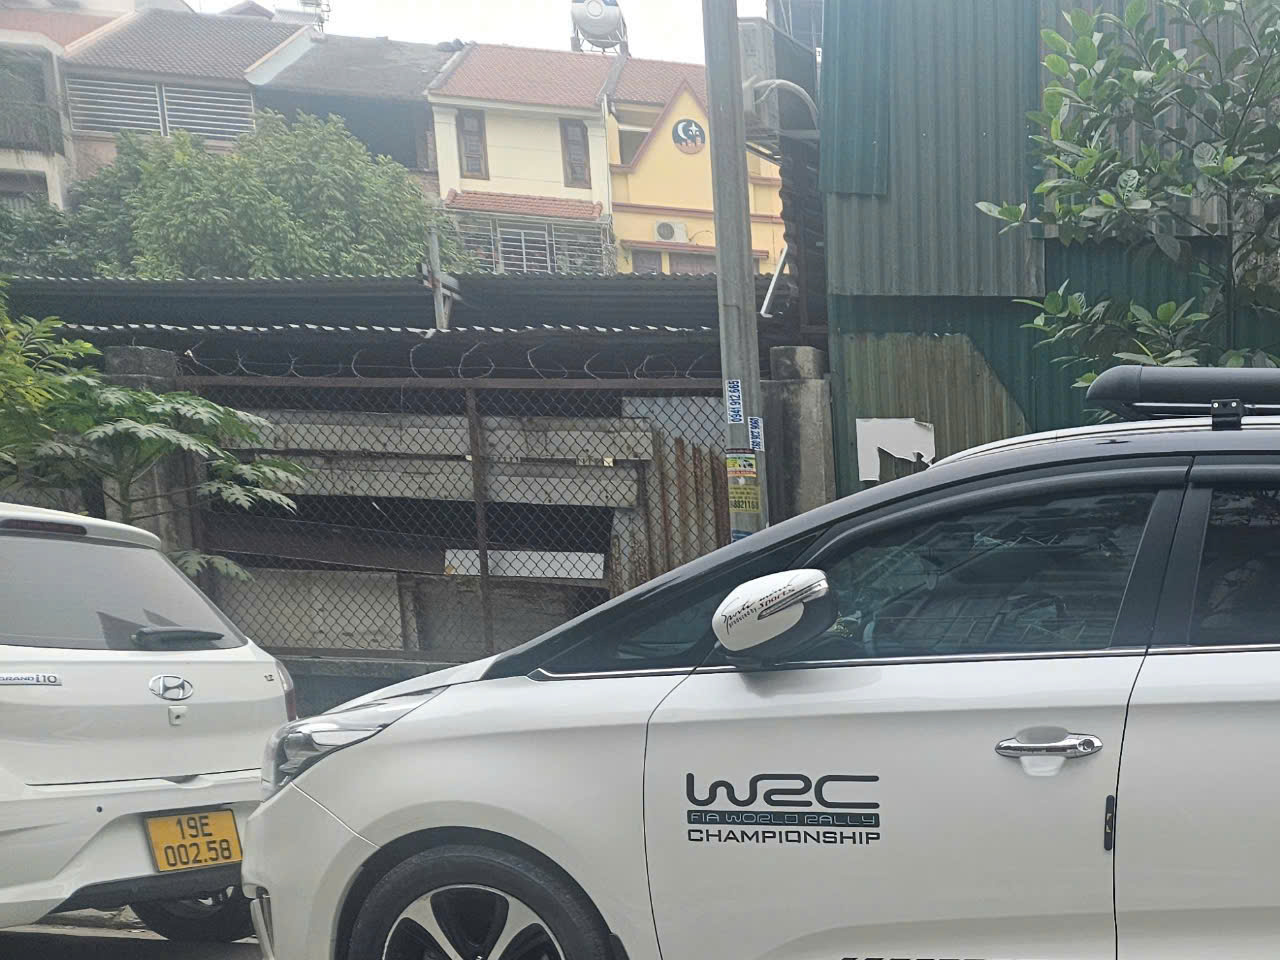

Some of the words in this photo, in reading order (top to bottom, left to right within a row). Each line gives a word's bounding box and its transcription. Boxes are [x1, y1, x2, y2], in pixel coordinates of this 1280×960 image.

[35, 674, 57, 684] i10
[686, 772, 880, 810] WRC
[175, 814, 213, 841] 19E
[690, 813, 720, 823] FIA
[725, 813, 799, 824] WORLD
[804, 815, 876, 825] RALLY
[687, 829, 881, 845] CHAMPIONSHIP
[163, 838, 233, 868] 002.58
